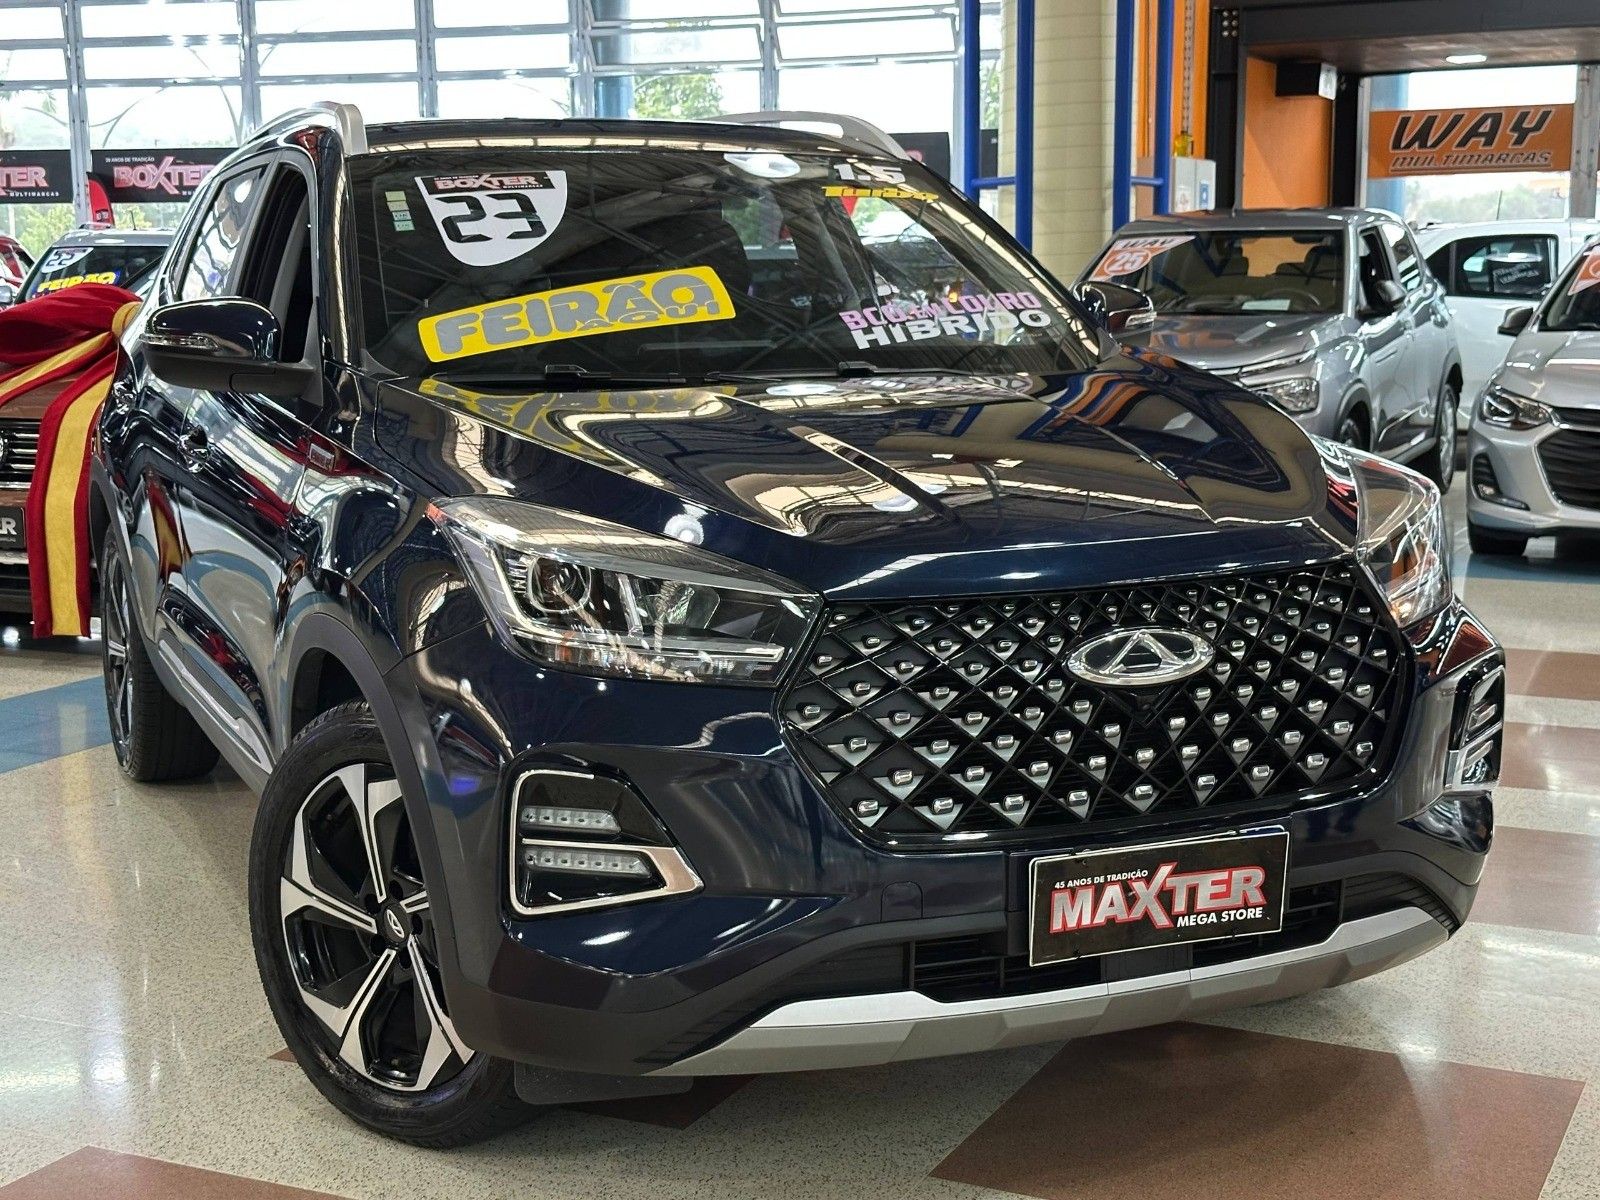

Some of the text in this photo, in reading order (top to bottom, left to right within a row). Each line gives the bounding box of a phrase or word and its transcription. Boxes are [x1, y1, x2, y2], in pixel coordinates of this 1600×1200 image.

[1390, 108, 1554, 151] WAY
[1390, 150, 1552, 169] MULTIMARCAS
[434, 173, 540, 190] BOXTER
[833, 163, 906, 184] 1.5
[435, 192, 547, 244] 23
[1107, 250, 1147, 272] 25
[435, 273, 719, 355] FEIRÃO
[1055, 869, 1149, 889] 45 ANOS DE TRADIÇÃO
[1050, 861, 1267, 933] MAXTER
[1177, 907, 1263, 928] MEGA STORE
